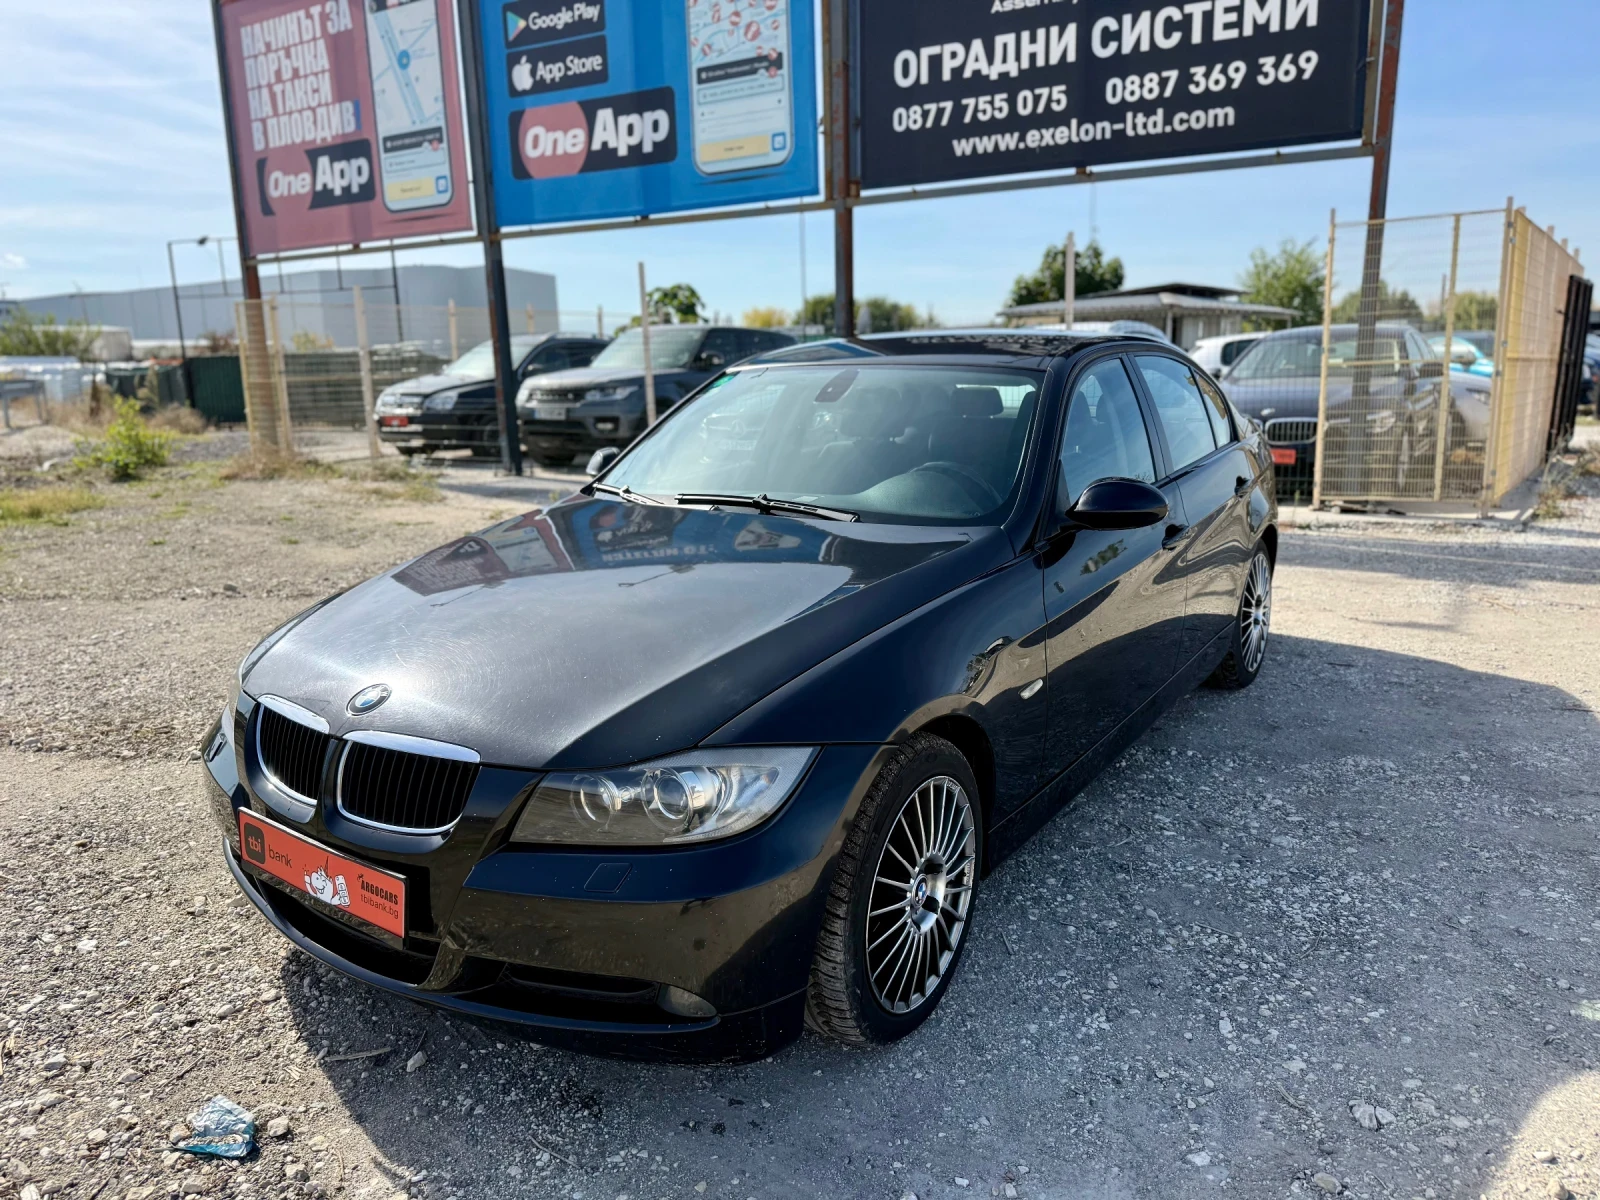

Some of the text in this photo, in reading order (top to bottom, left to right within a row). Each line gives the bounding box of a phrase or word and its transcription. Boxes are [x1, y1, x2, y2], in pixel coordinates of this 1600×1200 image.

[240, 0, 353, 58] НАЧИНЪТ ЗА
[528, 2, 601, 31] Google Play
[244, 38, 330, 89] ПОРЪЧКА
[893, 0, 1319, 88] ОГРАДНИ СИСТЕМИ
[535, 54, 603, 84] App Store
[1105, 50, 1319, 105] 0887 369 369
[247, 72, 333, 121] НА ТАКСИ
[892, 85, 1068, 132] 0877 755 075
[252, 100, 357, 151] В ПЛОВДИВ
[524, 107, 670, 159] One App
[952, 106, 1236, 157] www.exelon-ltd.com
[268, 155, 370, 198] One App
[248, 836, 262, 853] tbi
[268, 844, 293, 869] bank
[360, 881, 399, 906] ARGOCARS
[360, 894, 399, 919] tbibank.bg
